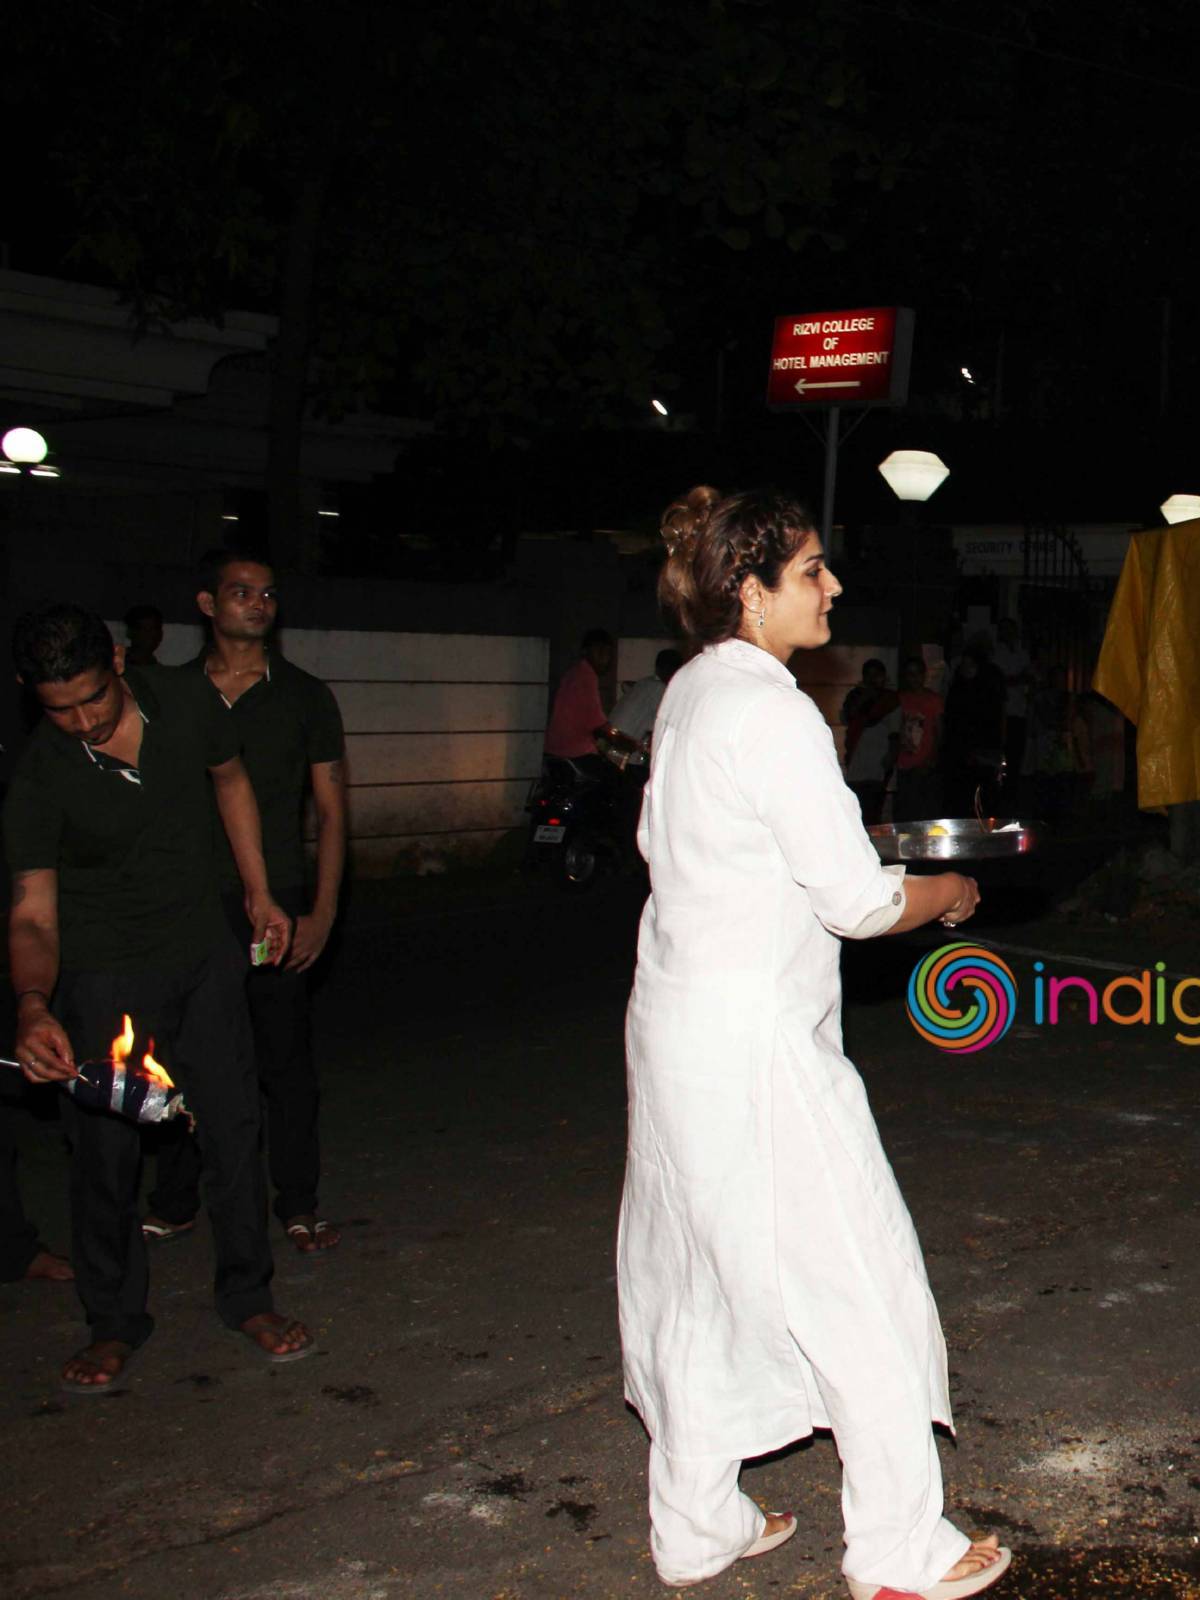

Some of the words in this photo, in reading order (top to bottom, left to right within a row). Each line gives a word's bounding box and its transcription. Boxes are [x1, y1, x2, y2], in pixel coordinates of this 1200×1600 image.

[793, 321, 820, 336] RIZVI
[822, 317, 875, 334] COLLEGE
[823, 337, 839, 350] OF
[773, 356, 807, 370] HOTEL
[810, 351, 888, 368] MANAGEMENT
